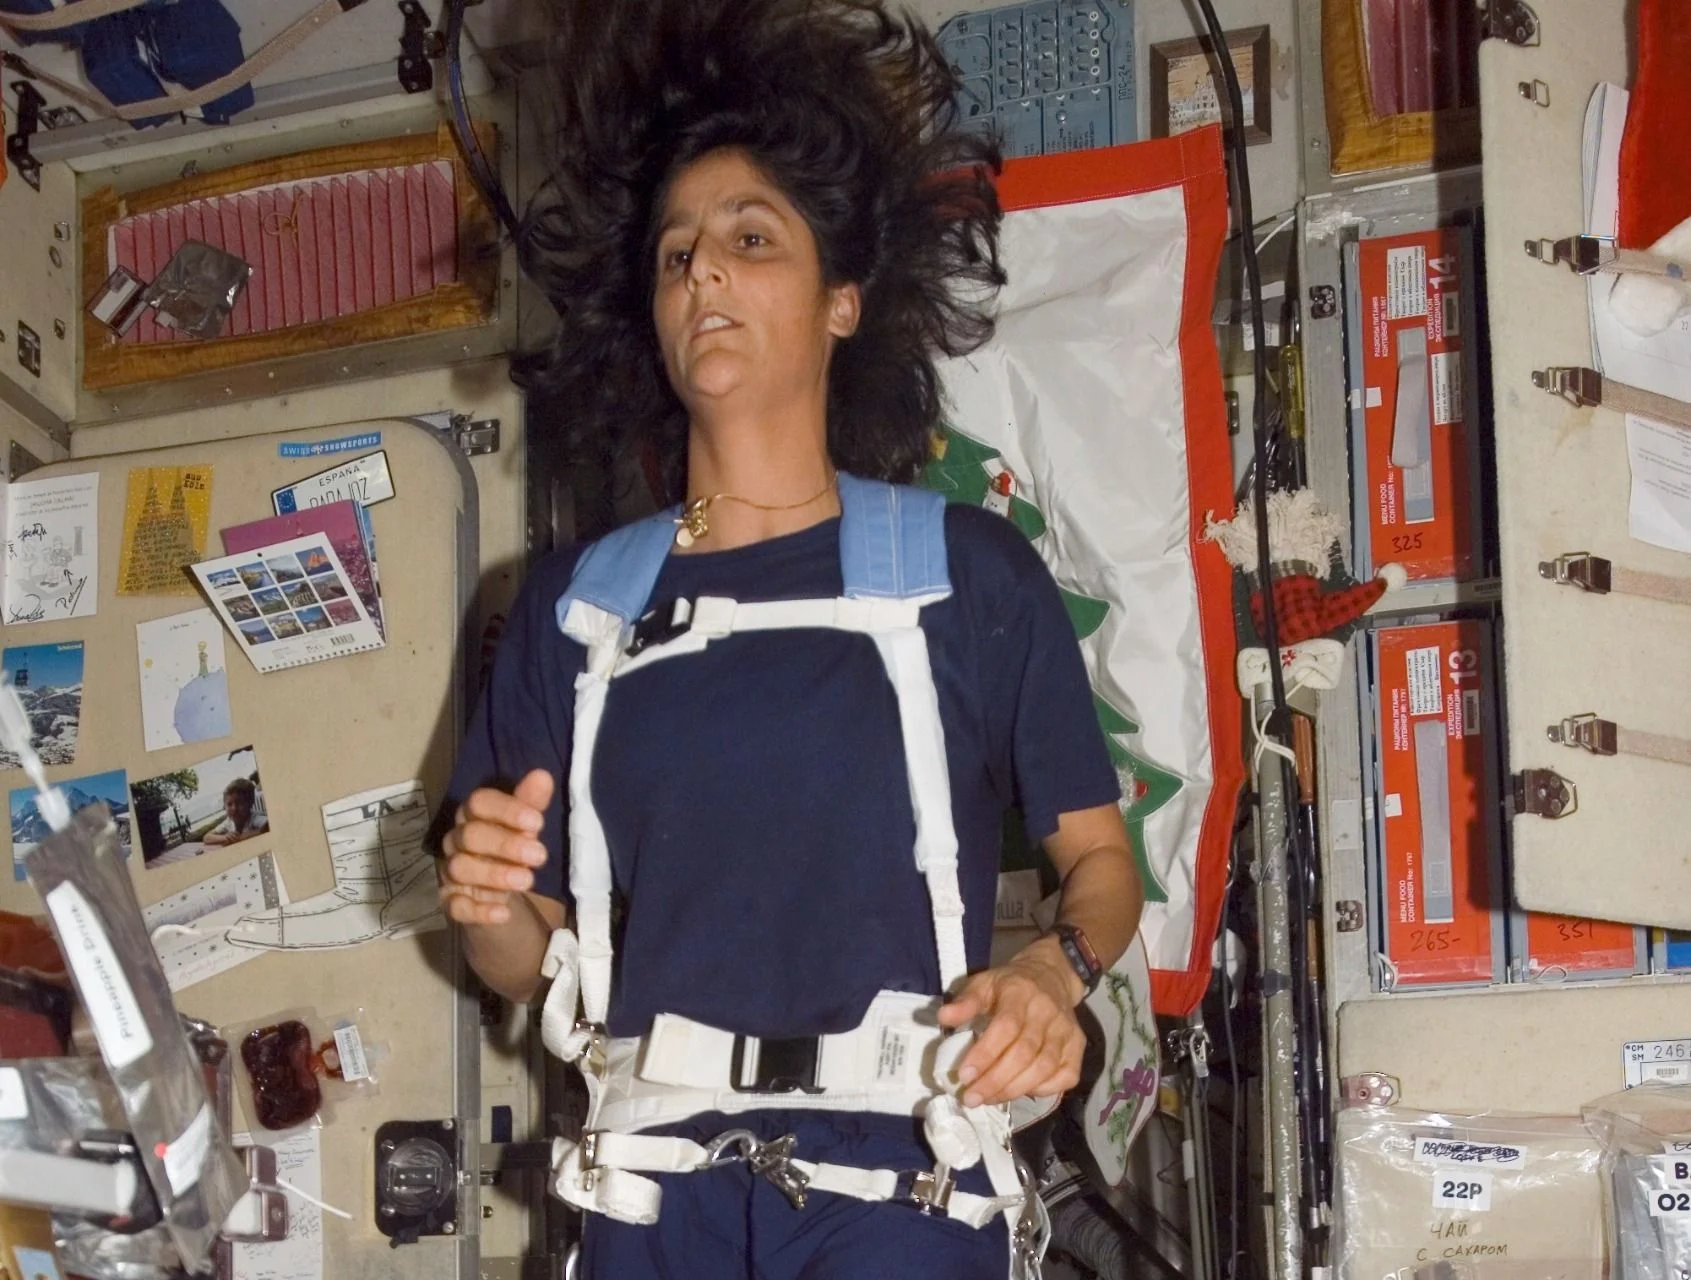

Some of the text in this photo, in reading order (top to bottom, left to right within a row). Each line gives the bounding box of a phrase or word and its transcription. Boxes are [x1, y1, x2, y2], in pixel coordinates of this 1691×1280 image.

[1428, 253, 1457, 289] 14
[324, 436, 378, 452] SNOWSPORTS
[1380, 483, 1389, 525] MENU FOOD
[1388, 484, 1396, 523] CONTAINER
[1391, 532, 1424, 554] 325
[1448, 649, 1477, 685] 13
[1447, 694, 1455, 736] EXPEDITION
[1407, 884, 1415, 922] CONTAINER
[92, 955, 134, 1041] Pineapple
[1654, 1043, 1691, 1059] 246
[1442, 1181, 1483, 1199] 22P
